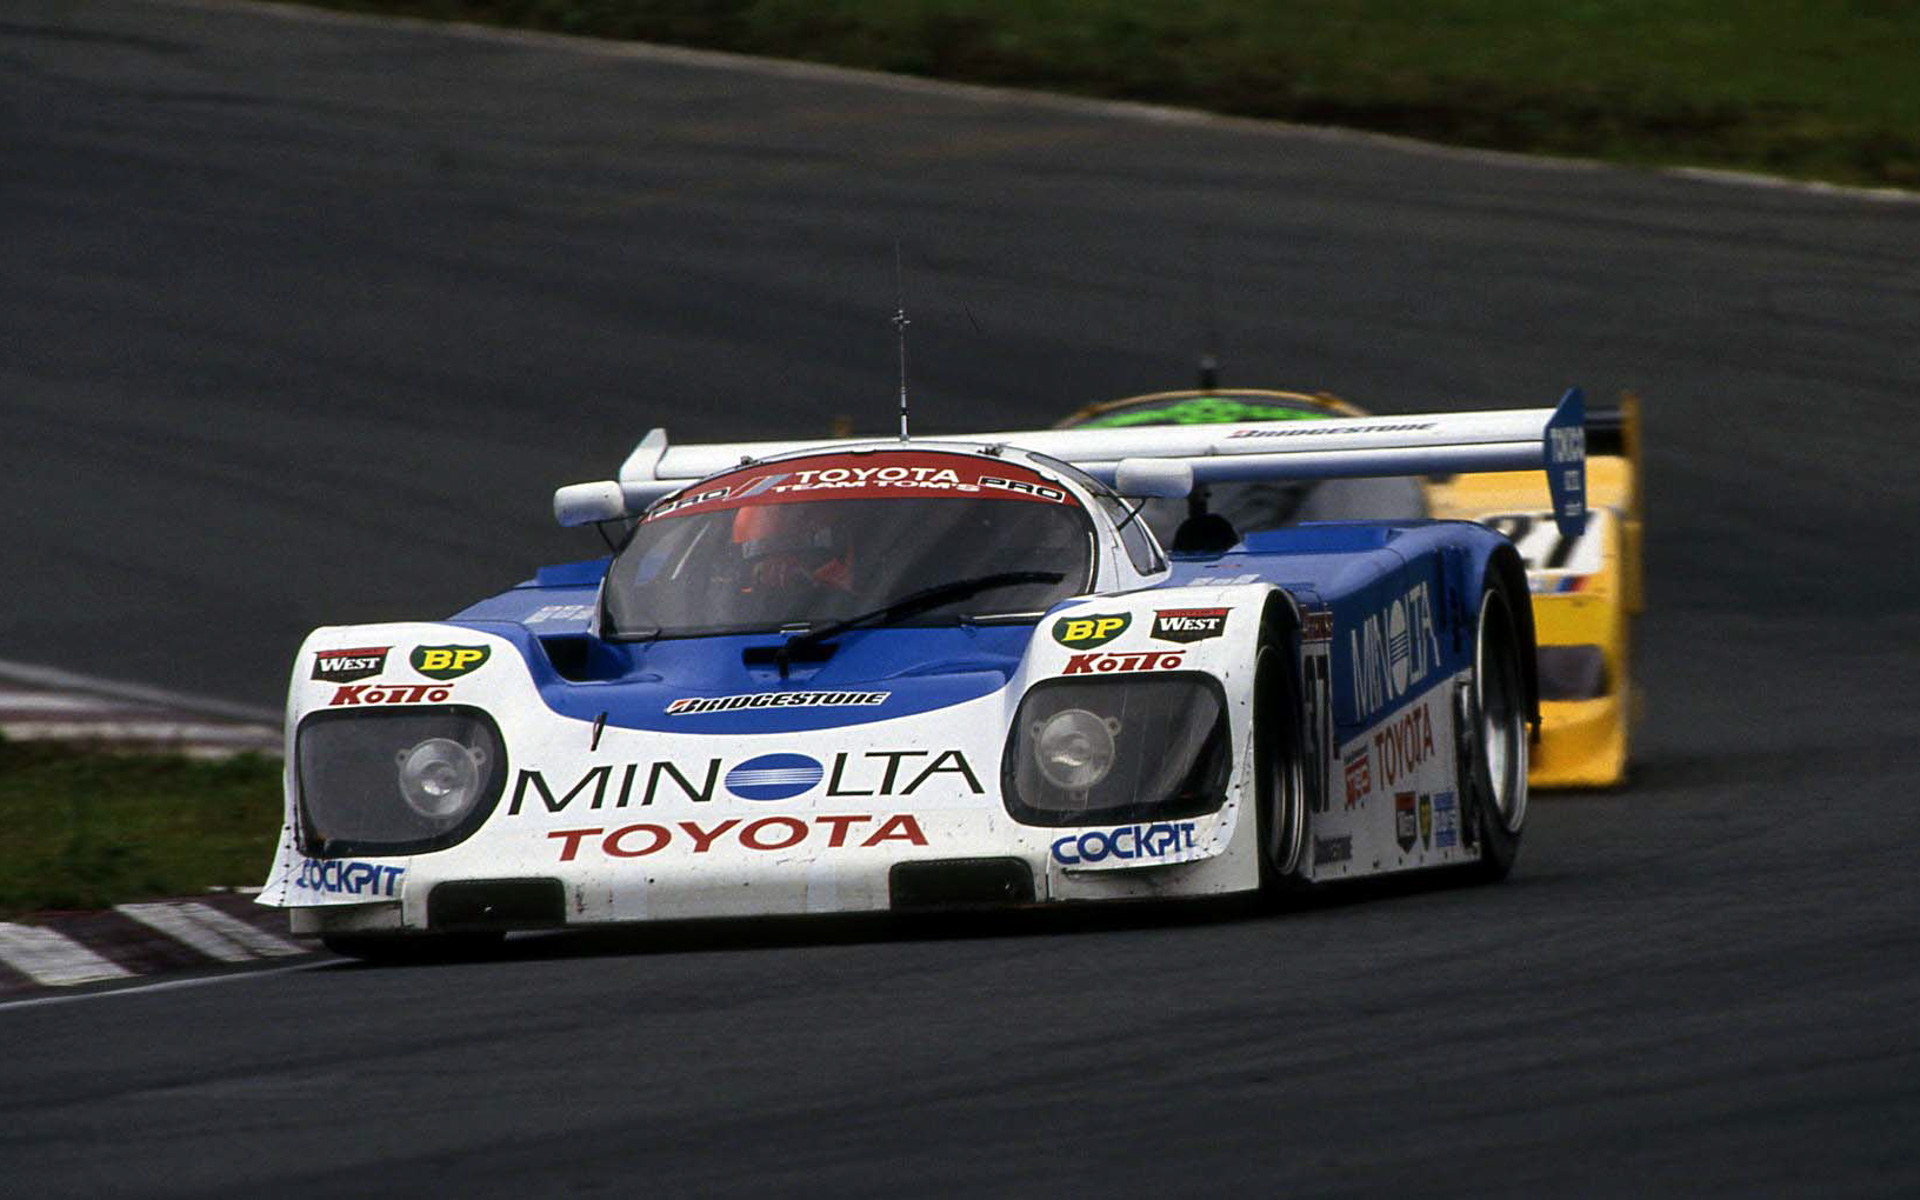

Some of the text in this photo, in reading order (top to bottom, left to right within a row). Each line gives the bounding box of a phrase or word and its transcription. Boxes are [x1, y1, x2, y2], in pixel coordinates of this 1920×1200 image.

[1227, 423, 1437, 439] BRIDGESTONE
[773, 481, 861, 493] TEAM
[796, 467, 960, 484] TOYOTA
[978, 477, 1064, 501] PRO
[1061, 617, 1124, 642] BP
[1159, 617, 1220, 632] WEST
[319, 657, 381, 672] WEST
[418, 649, 484, 671] BP
[1351, 581, 1442, 725] MINOLTA
[665, 691, 892, 716] BRIDGESTONE
[1374, 702, 1435, 791] TOYOTA
[507, 750, 985, 816] MINOLTA
[547, 814, 930, 862] TOYOTA
[1051, 823, 1197, 865] COCKPIT
[295, 859, 406, 896] COCKPIT
